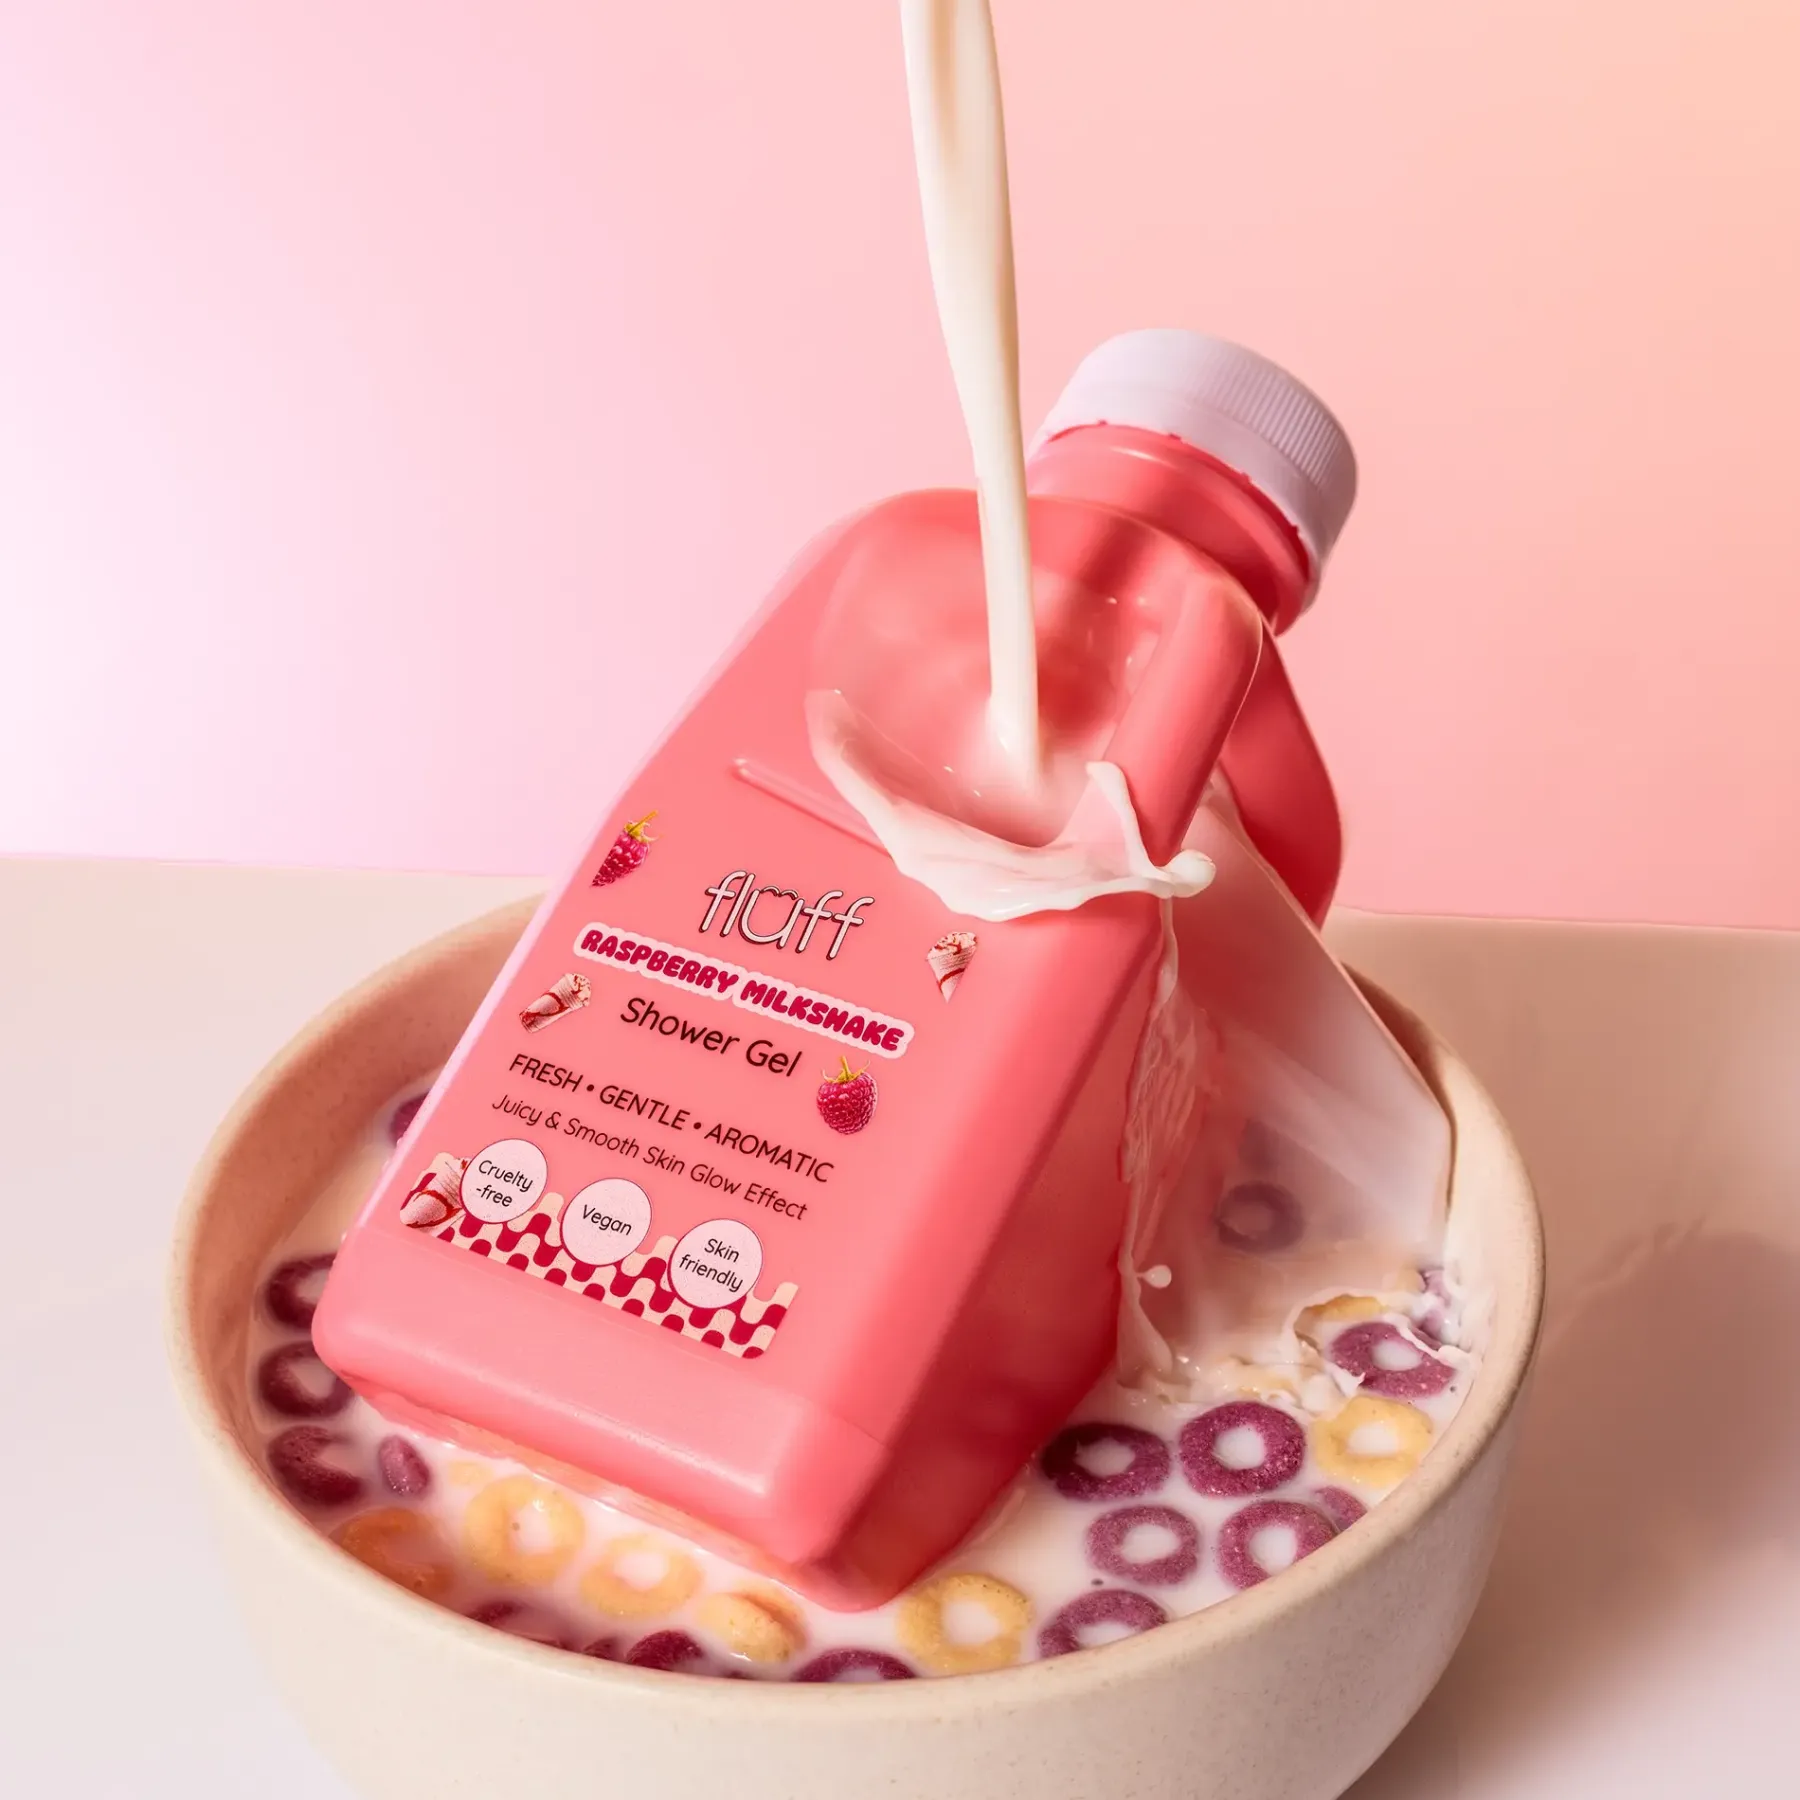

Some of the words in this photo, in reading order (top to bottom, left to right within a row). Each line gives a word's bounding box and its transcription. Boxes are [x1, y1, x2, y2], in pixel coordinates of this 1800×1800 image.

[580, 929, 739, 993] RASPBERRY
[740, 980, 905, 1051] MILKSHAKE
[620, 998, 741, 1055] Shower
[745, 1040, 803, 1077] Gel
[509, 1053, 585, 1093] FRESH
[599, 1084, 691, 1131] GENTLE
[704, 1122, 835, 1183] AROMATIC
[478, 1159, 534, 1193] Cruelty
[492, 1094, 543, 1127] Juicy
[545, 1111, 560, 1130] &
[563, 1118, 640, 1159] Smooth
[642, 1146, 686, 1176] Skin
[690, 1163, 743, 1195] Glow
[743, 1183, 808, 1221] Effect
[476, 1184, 513, 1208] -free
[582, 1204, 632, 1236] Vegan
[704, 1238, 740, 1263] Skin
[679, 1254, 744, 1293] friendly
